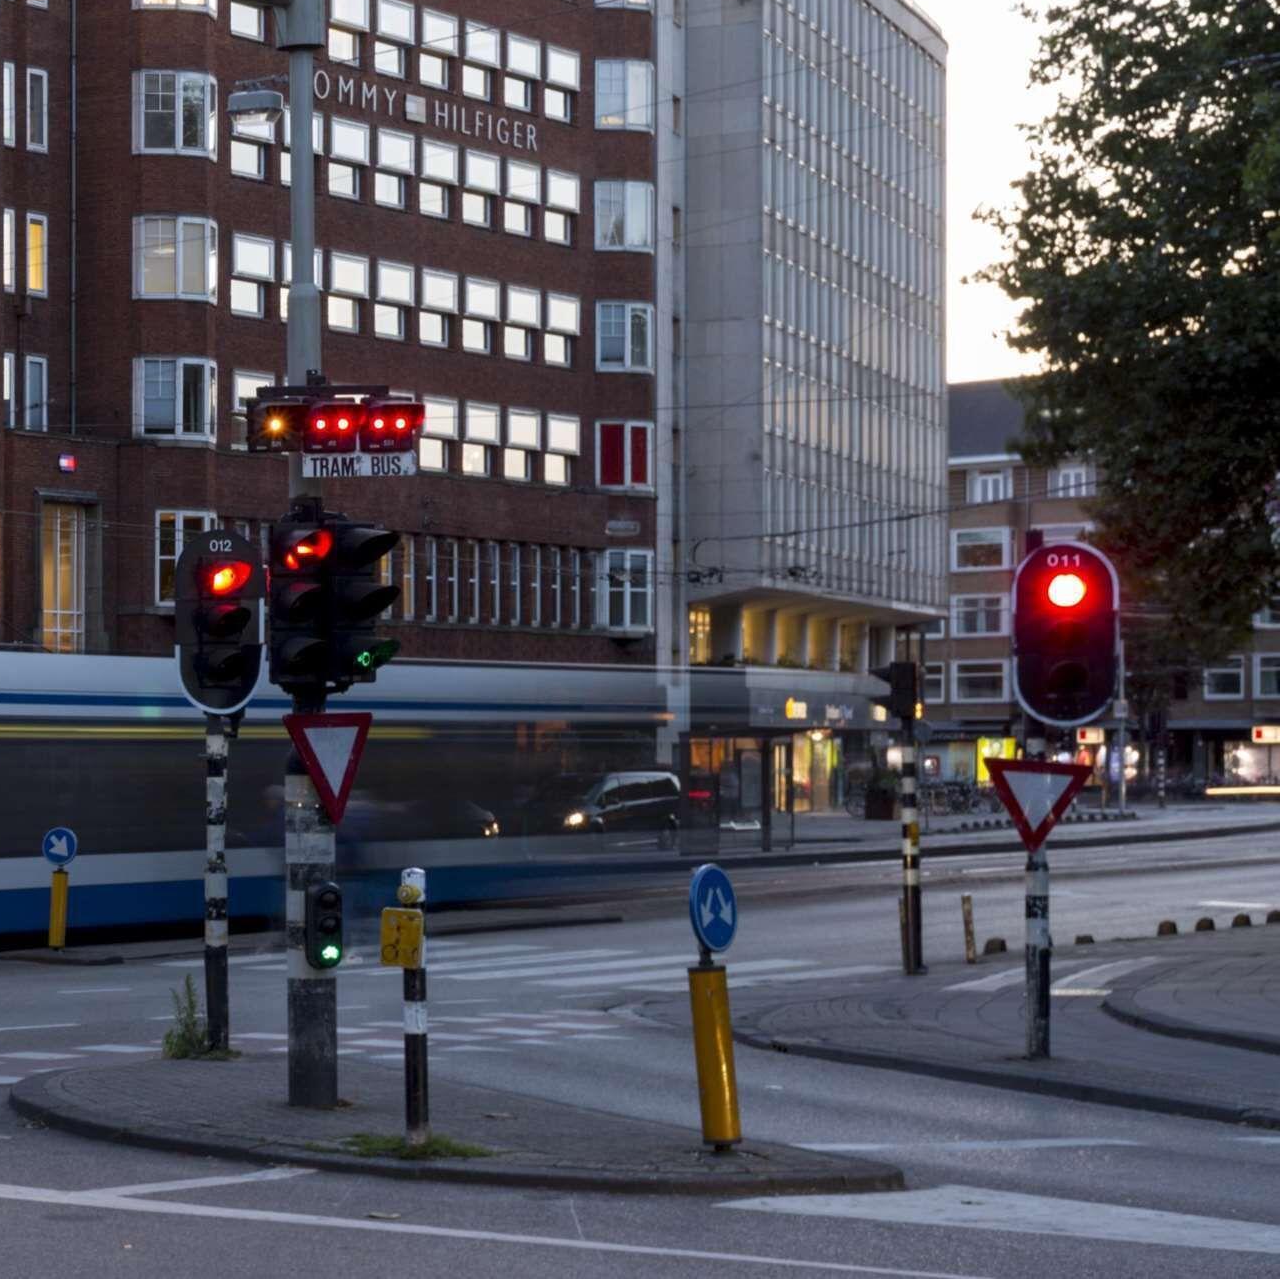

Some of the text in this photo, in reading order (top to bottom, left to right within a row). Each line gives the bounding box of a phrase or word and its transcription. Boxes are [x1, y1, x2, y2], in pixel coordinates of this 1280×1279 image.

[313, 69, 539, 152] OMMY HILFIGER
[311, 455, 402, 476] TRAM BUS
[209, 539, 233, 552] 012
[1046, 553, 1081, 568] 011
